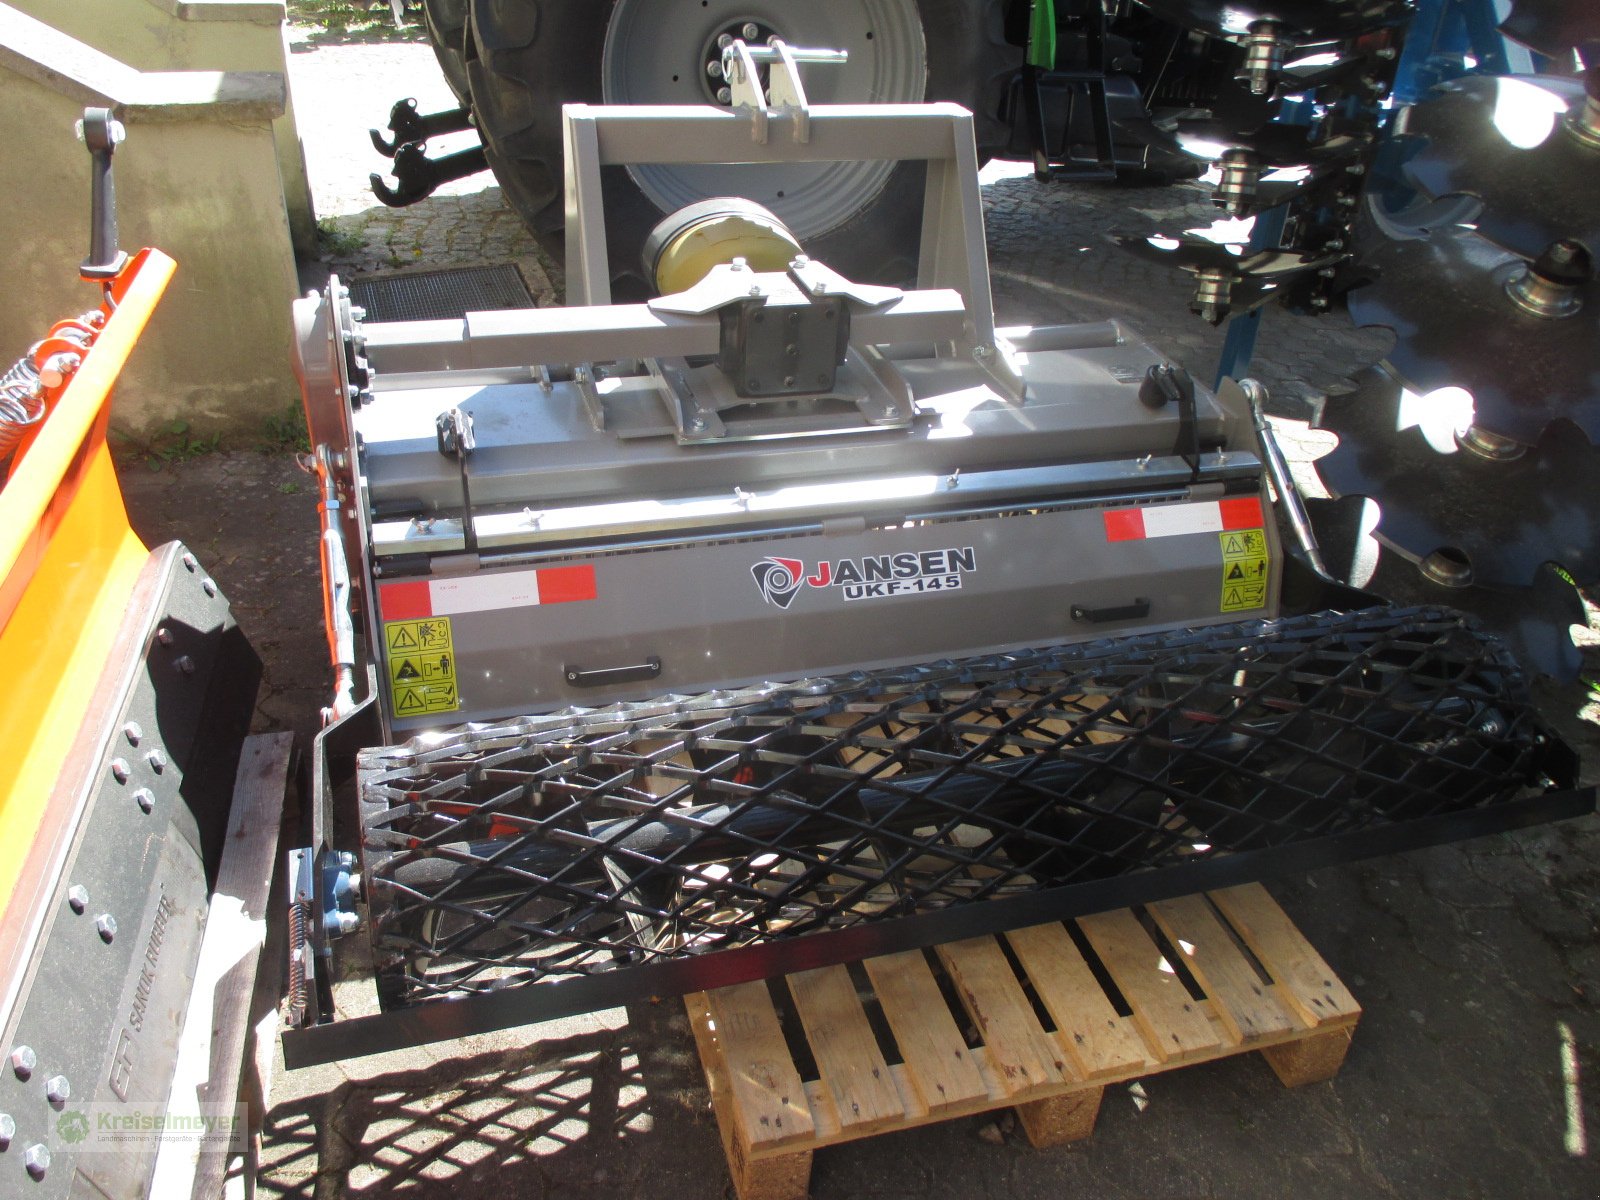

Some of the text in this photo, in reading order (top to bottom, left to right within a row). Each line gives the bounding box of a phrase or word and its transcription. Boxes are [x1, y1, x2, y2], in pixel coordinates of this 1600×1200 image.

[807, 547, 976, 587] JANSEN
[844, 575, 963, 601] UKF-145
[129, 894, 174, 1033] SANOK RUBBER
